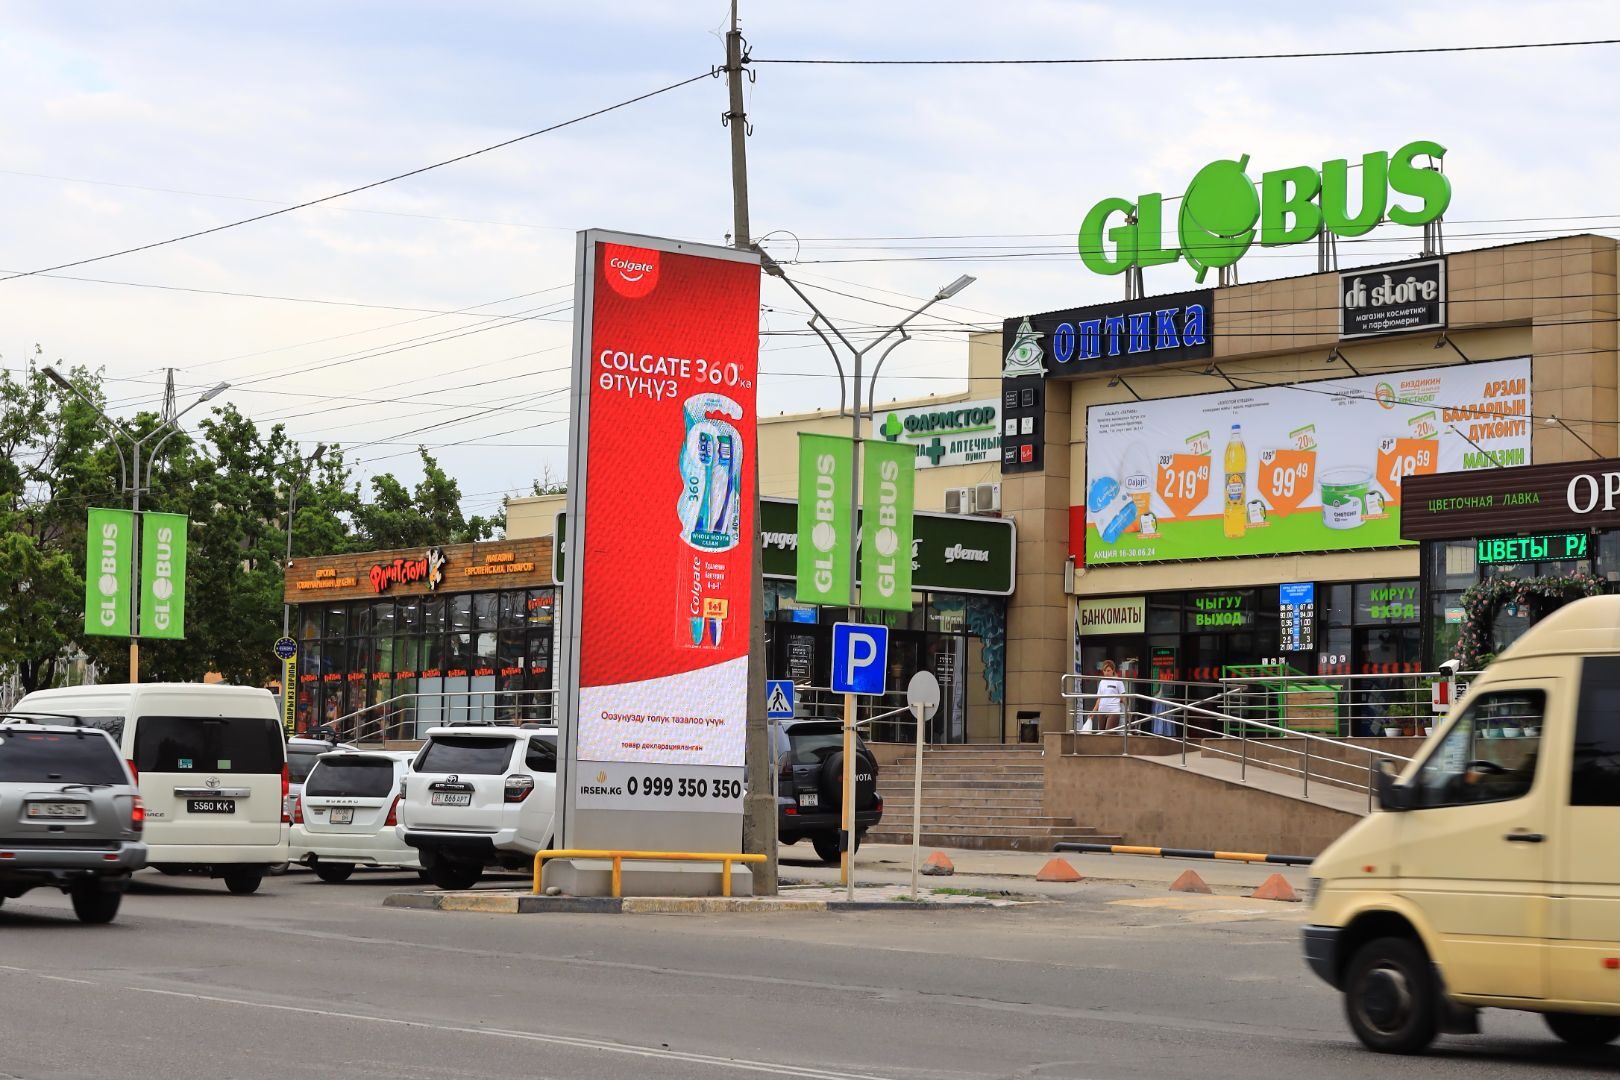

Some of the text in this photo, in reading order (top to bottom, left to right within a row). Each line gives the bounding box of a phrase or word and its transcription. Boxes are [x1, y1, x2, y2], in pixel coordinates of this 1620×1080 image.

[1078, 140, 1452, 283] GLOBUS
[610, 257, 653, 273] Colgate
[1345, 274, 1438, 310] di store
[1356, 306, 1426, 322] магазин косметики
[1368, 317, 1420, 330] парфюмерии
[599, 349, 691, 378] COLGATE
[1400, 377, 1441, 389] БИЗДИКИН
[1483, 378, 1526, 398] АРЗАН
[904, 406, 996, 433] ФАРМСТОР
[1442, 399, 1526, 423] БААЛАРДЫН
[949, 432, 1002, 454] АПТЕЧНЫЙ
[1468, 420, 1526, 444] ДҮКӨНҮ!
[1463, 447, 1525, 470] МАГАЗИН
[1428, 492, 1540, 513] ЦВЕТОЧНАЯ ЛАВКА
[811, 453, 837, 594] GLOBUS
[875, 459, 900, 598] GLOBUS
[944, 543, 990, 564] цветы
[1093, 549, 1118, 560] АКЦИЯ
[1478, 537, 1548, 563] ЦВЕТЫ
[98, 523, 119, 627] GLOBUS
[152, 527, 174, 631] GLOBUS
[690, 556, 702, 615] Colgate
[1196, 595, 1242, 610] ЧЫГУУ
[1371, 603, 1415, 619] ВХОД
[1081, 606, 1142, 626] БАНКОМАТЫ
[1195, 611, 1242, 627] ВЫХОД
[846, 632, 877, 686] P
[580, 786, 622, 795] IRSEN.KG
[627, 776, 741, 799] 0 999 350 350
[194, 802, 214, 811] 5560
